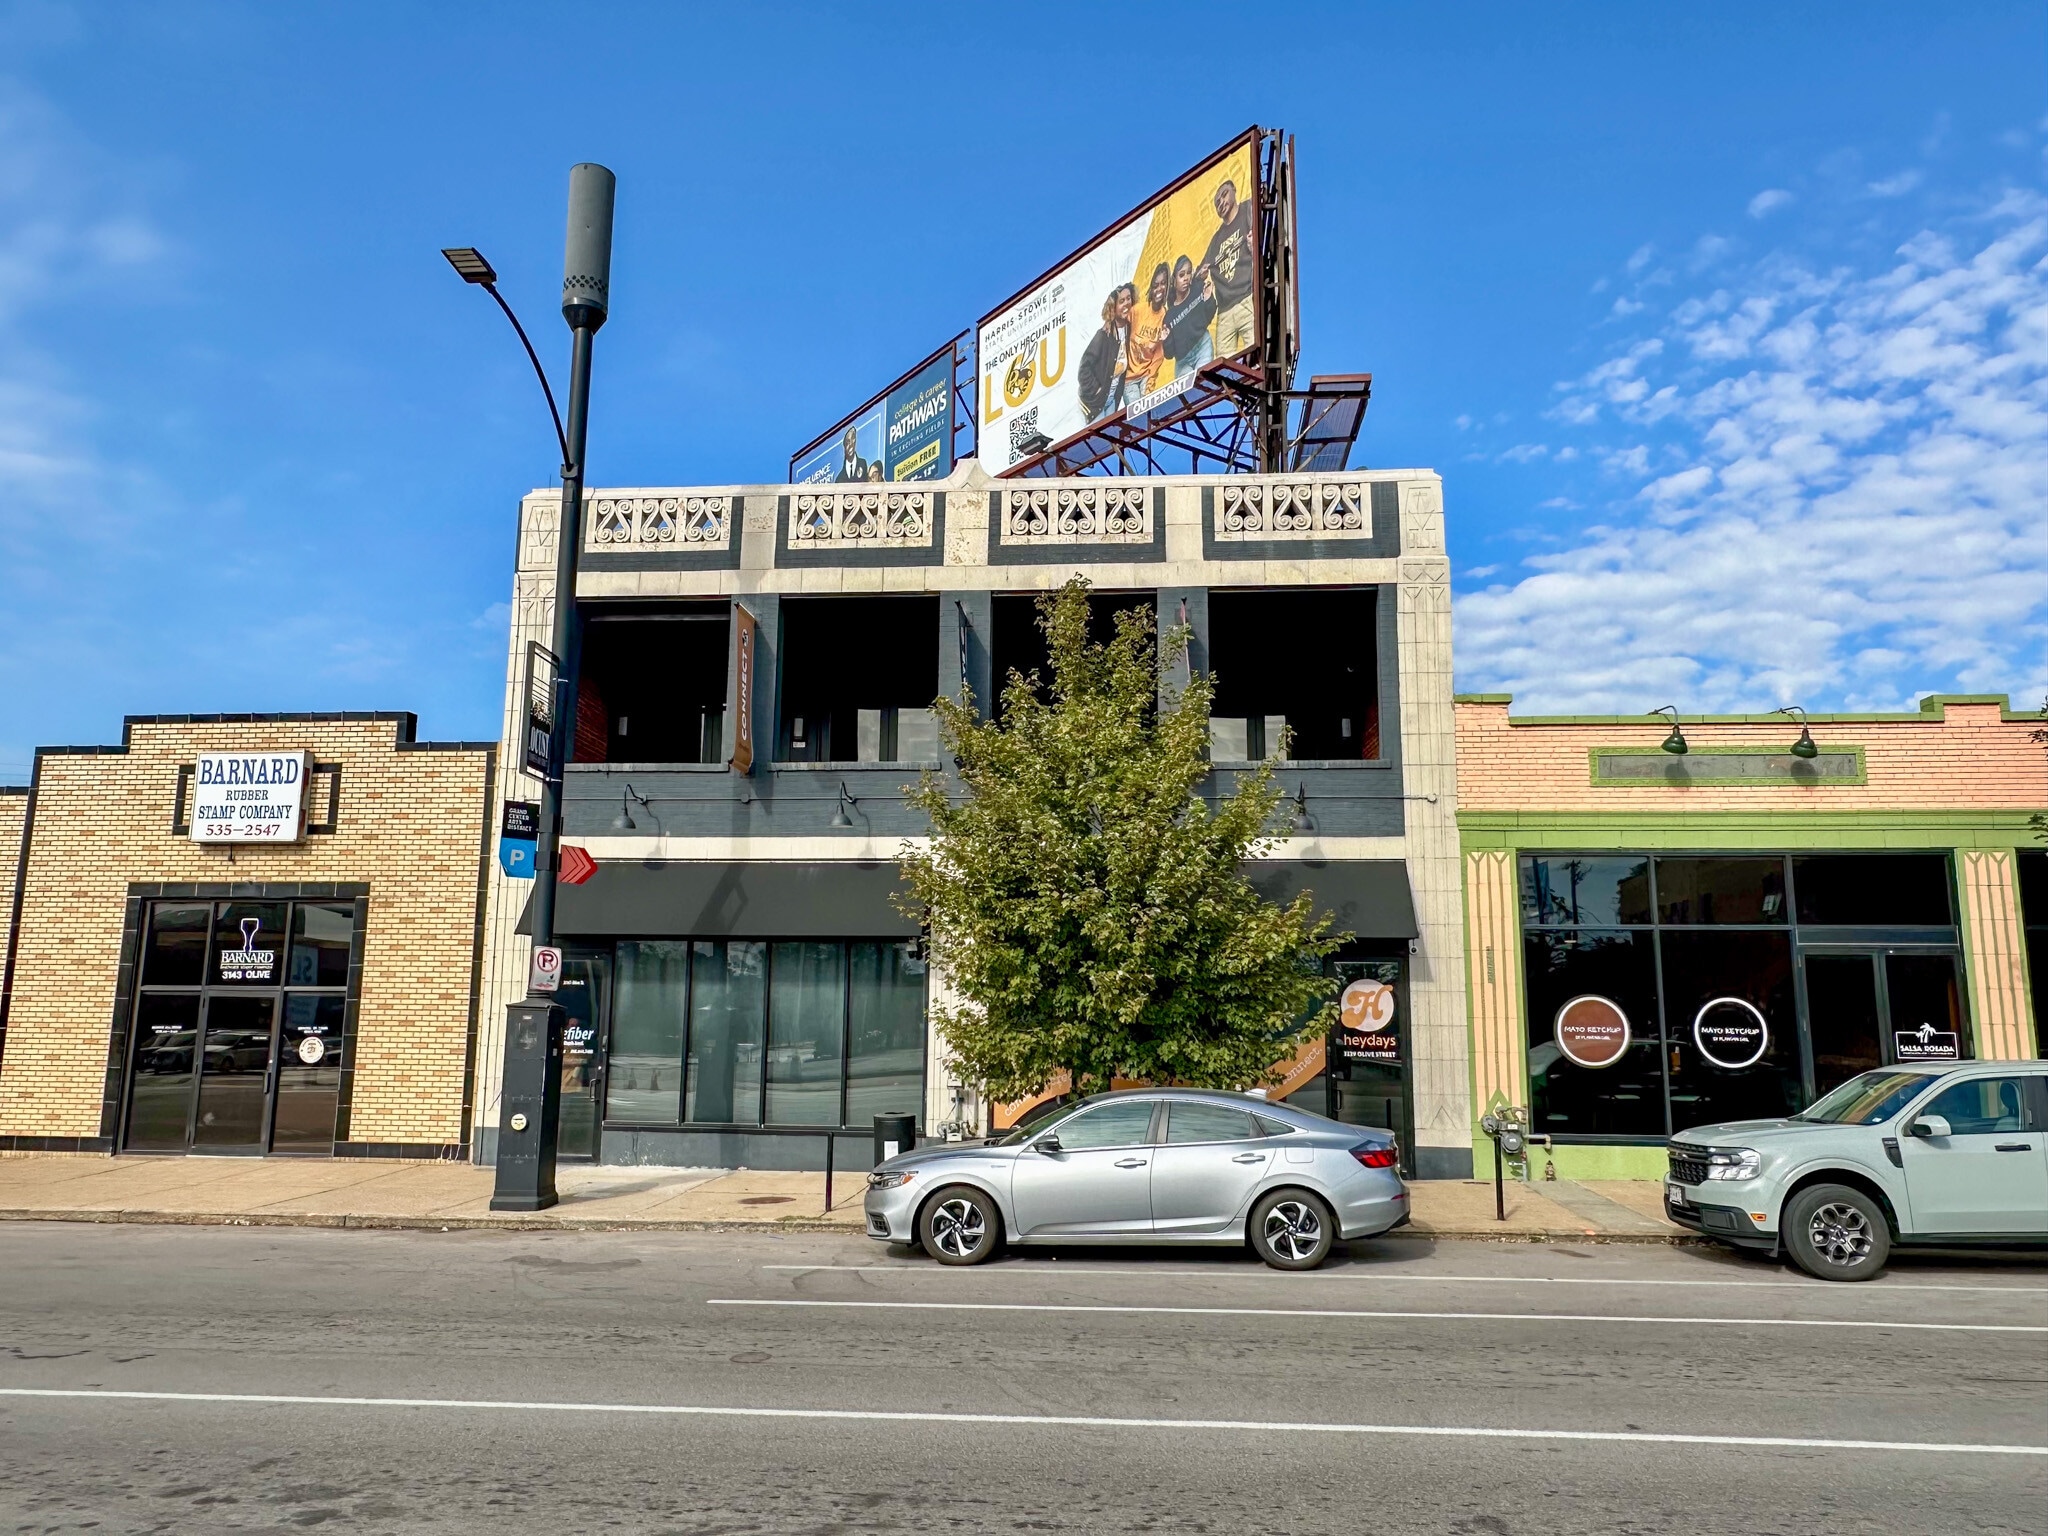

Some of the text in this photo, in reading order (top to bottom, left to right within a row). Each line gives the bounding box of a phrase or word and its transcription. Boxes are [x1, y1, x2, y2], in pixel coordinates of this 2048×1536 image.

[985, 356, 999, 372] THE
[1000, 342, 1019, 364] ONLY
[1041, 321, 1051, 337] IN
[1052, 311, 1067, 330] THE
[984, 325, 1067, 425] LOU
[1133, 375, 1190, 414] OUTFRONT
[889, 390, 947, 446] PATHWAYS
[919, 444, 937, 464] FREE
[741, 650, 749, 741] CONNECT
[528, 726, 550, 760] OCUST
[199, 758, 299, 785] BARNARD
[225, 789, 269, 801] RUBBER
[198, 805, 292, 820] STAMP COMPANY
[508, 813, 530, 821] CENTER
[205, 824, 280, 836] 535-2547
[510, 849, 525, 866] P
[221, 952, 274, 963] BARNARD
[221, 970, 271, 980] 3143 OLIVE
[1343, 1033, 1396, 1049] heydays
[1900, 1044, 1923, 1052] SALSA
